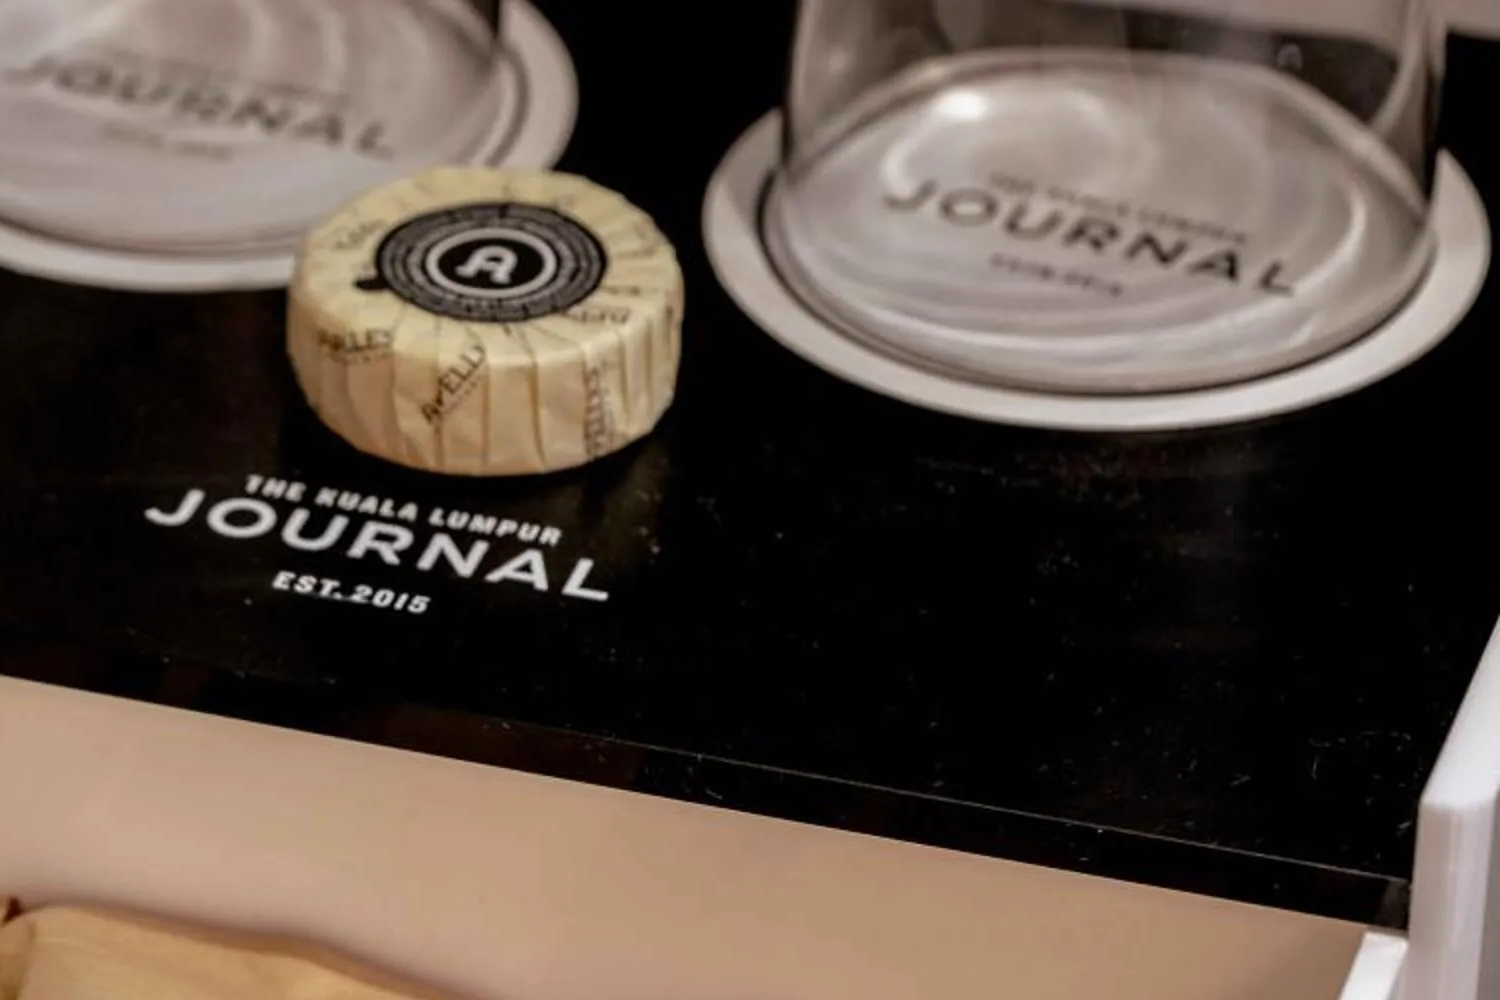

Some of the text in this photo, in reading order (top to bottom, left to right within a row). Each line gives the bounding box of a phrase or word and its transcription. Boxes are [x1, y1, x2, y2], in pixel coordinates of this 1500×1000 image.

[881, 179, 1293, 297] JOURNAL
[144, 488, 609, 601] JOURNAL
[244, 474, 564, 547] THE KUALA LUMPUR
